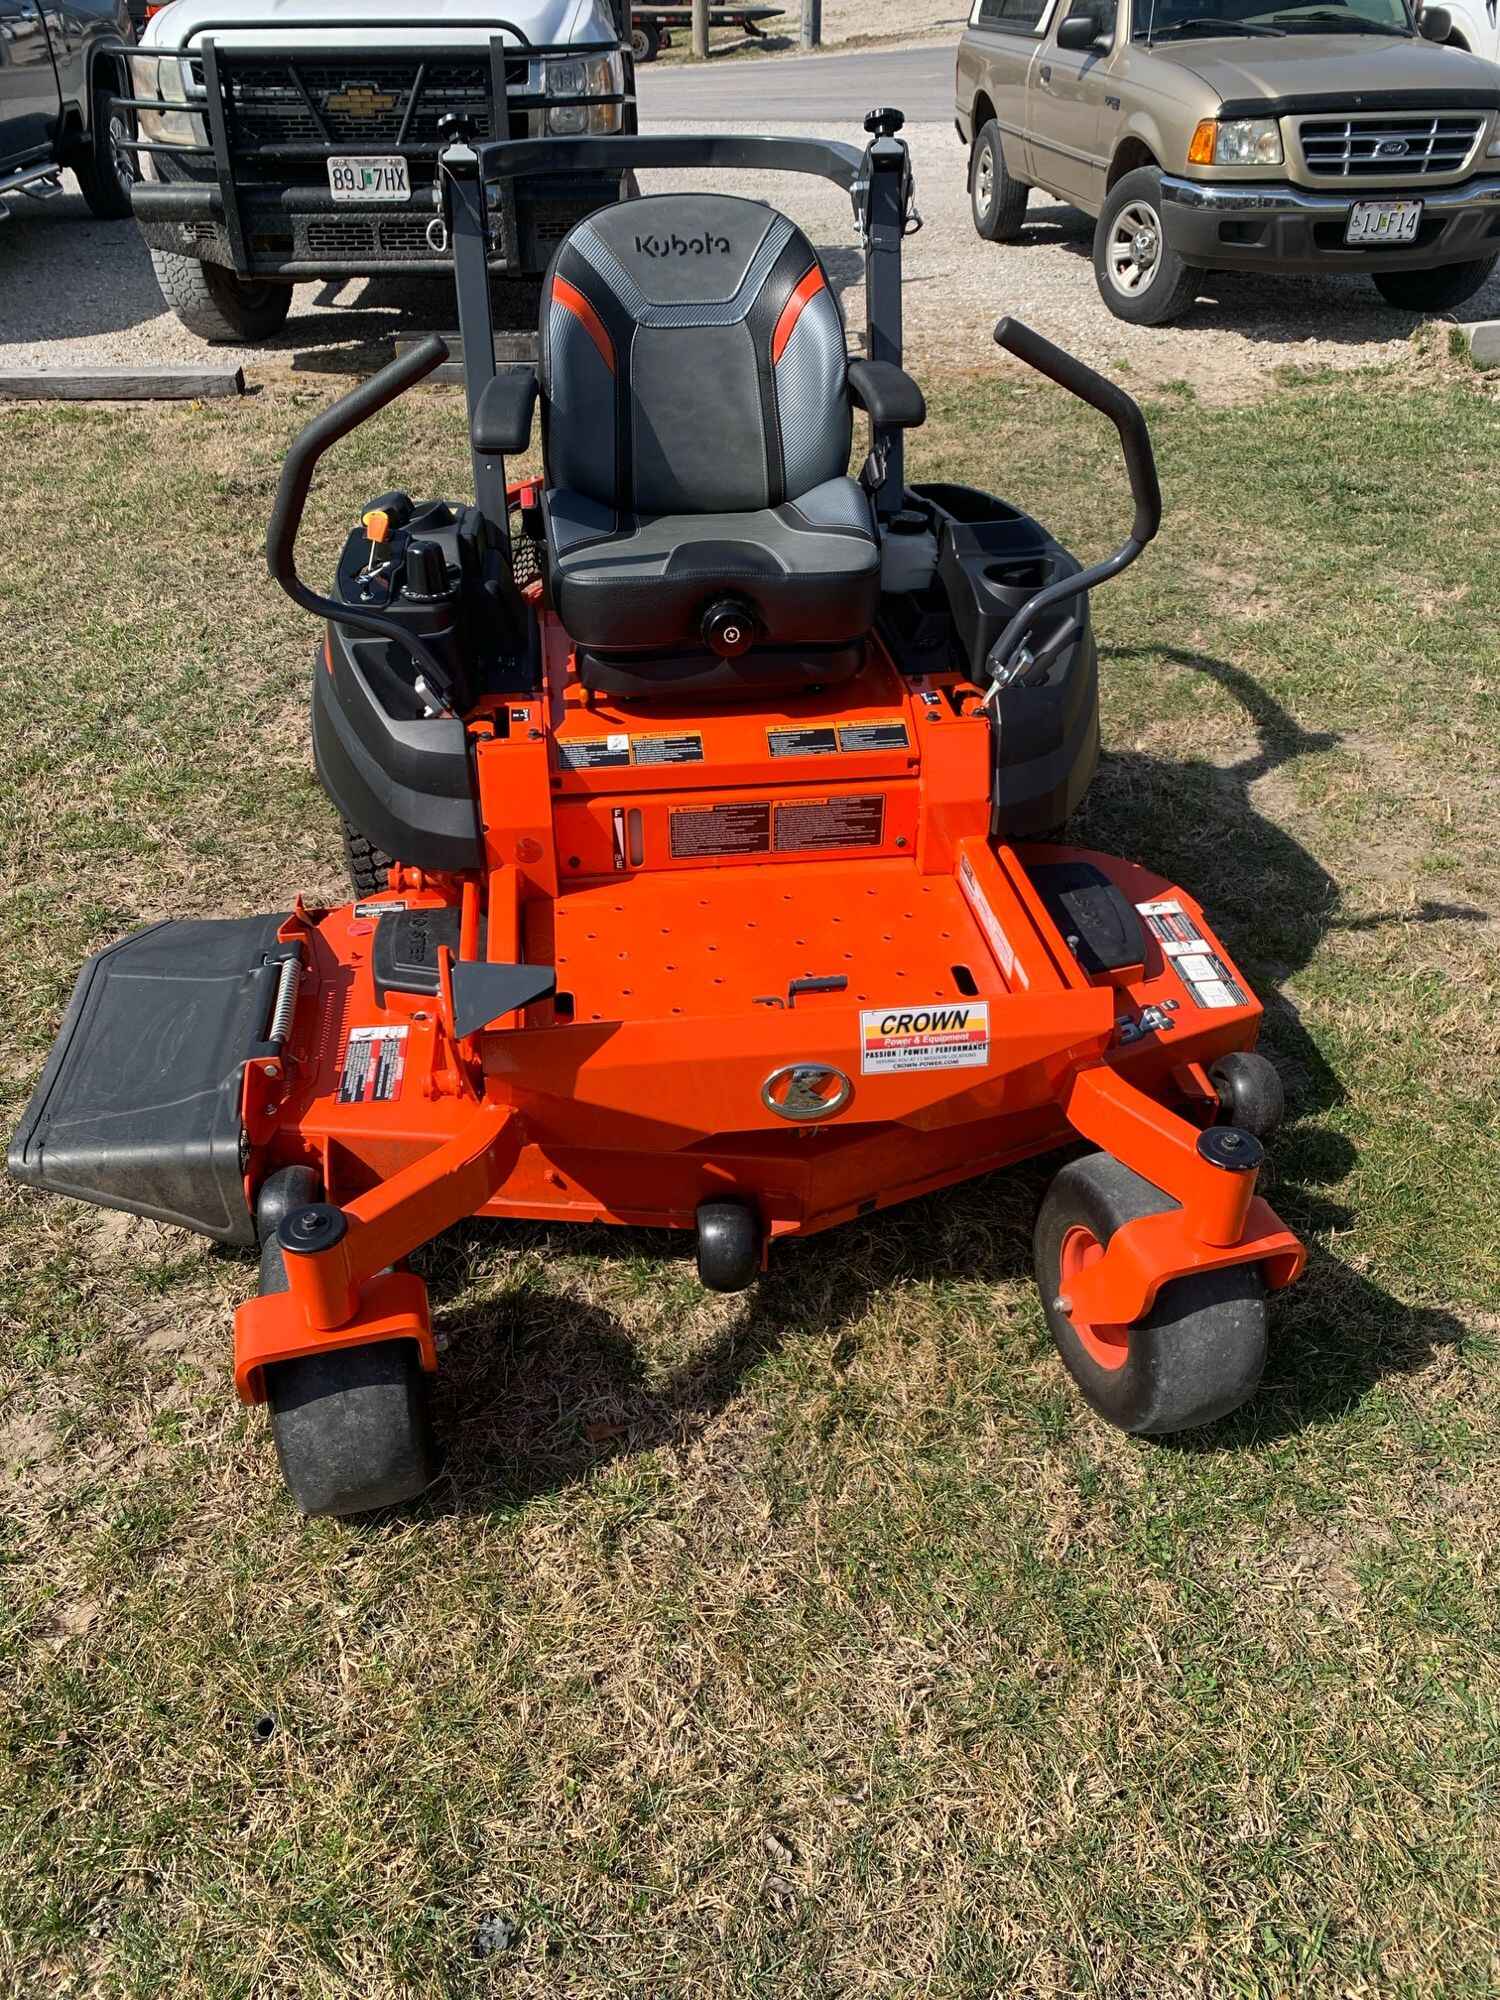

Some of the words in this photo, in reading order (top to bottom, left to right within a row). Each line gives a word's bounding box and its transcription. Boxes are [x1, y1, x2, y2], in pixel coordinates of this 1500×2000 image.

[634, 232, 730, 258] Kubota
[880, 1009, 970, 1035] CROWN
[865, 1050, 897, 1059] PASSION
[903, 1048, 929, 1056] POWER
[935, 1043, 987, 1054] PERFORMANCE
[884, 1037, 912, 1048] Power
[913, 1036, 920, 1045] &
[923, 1033, 970, 1045] Equipment
